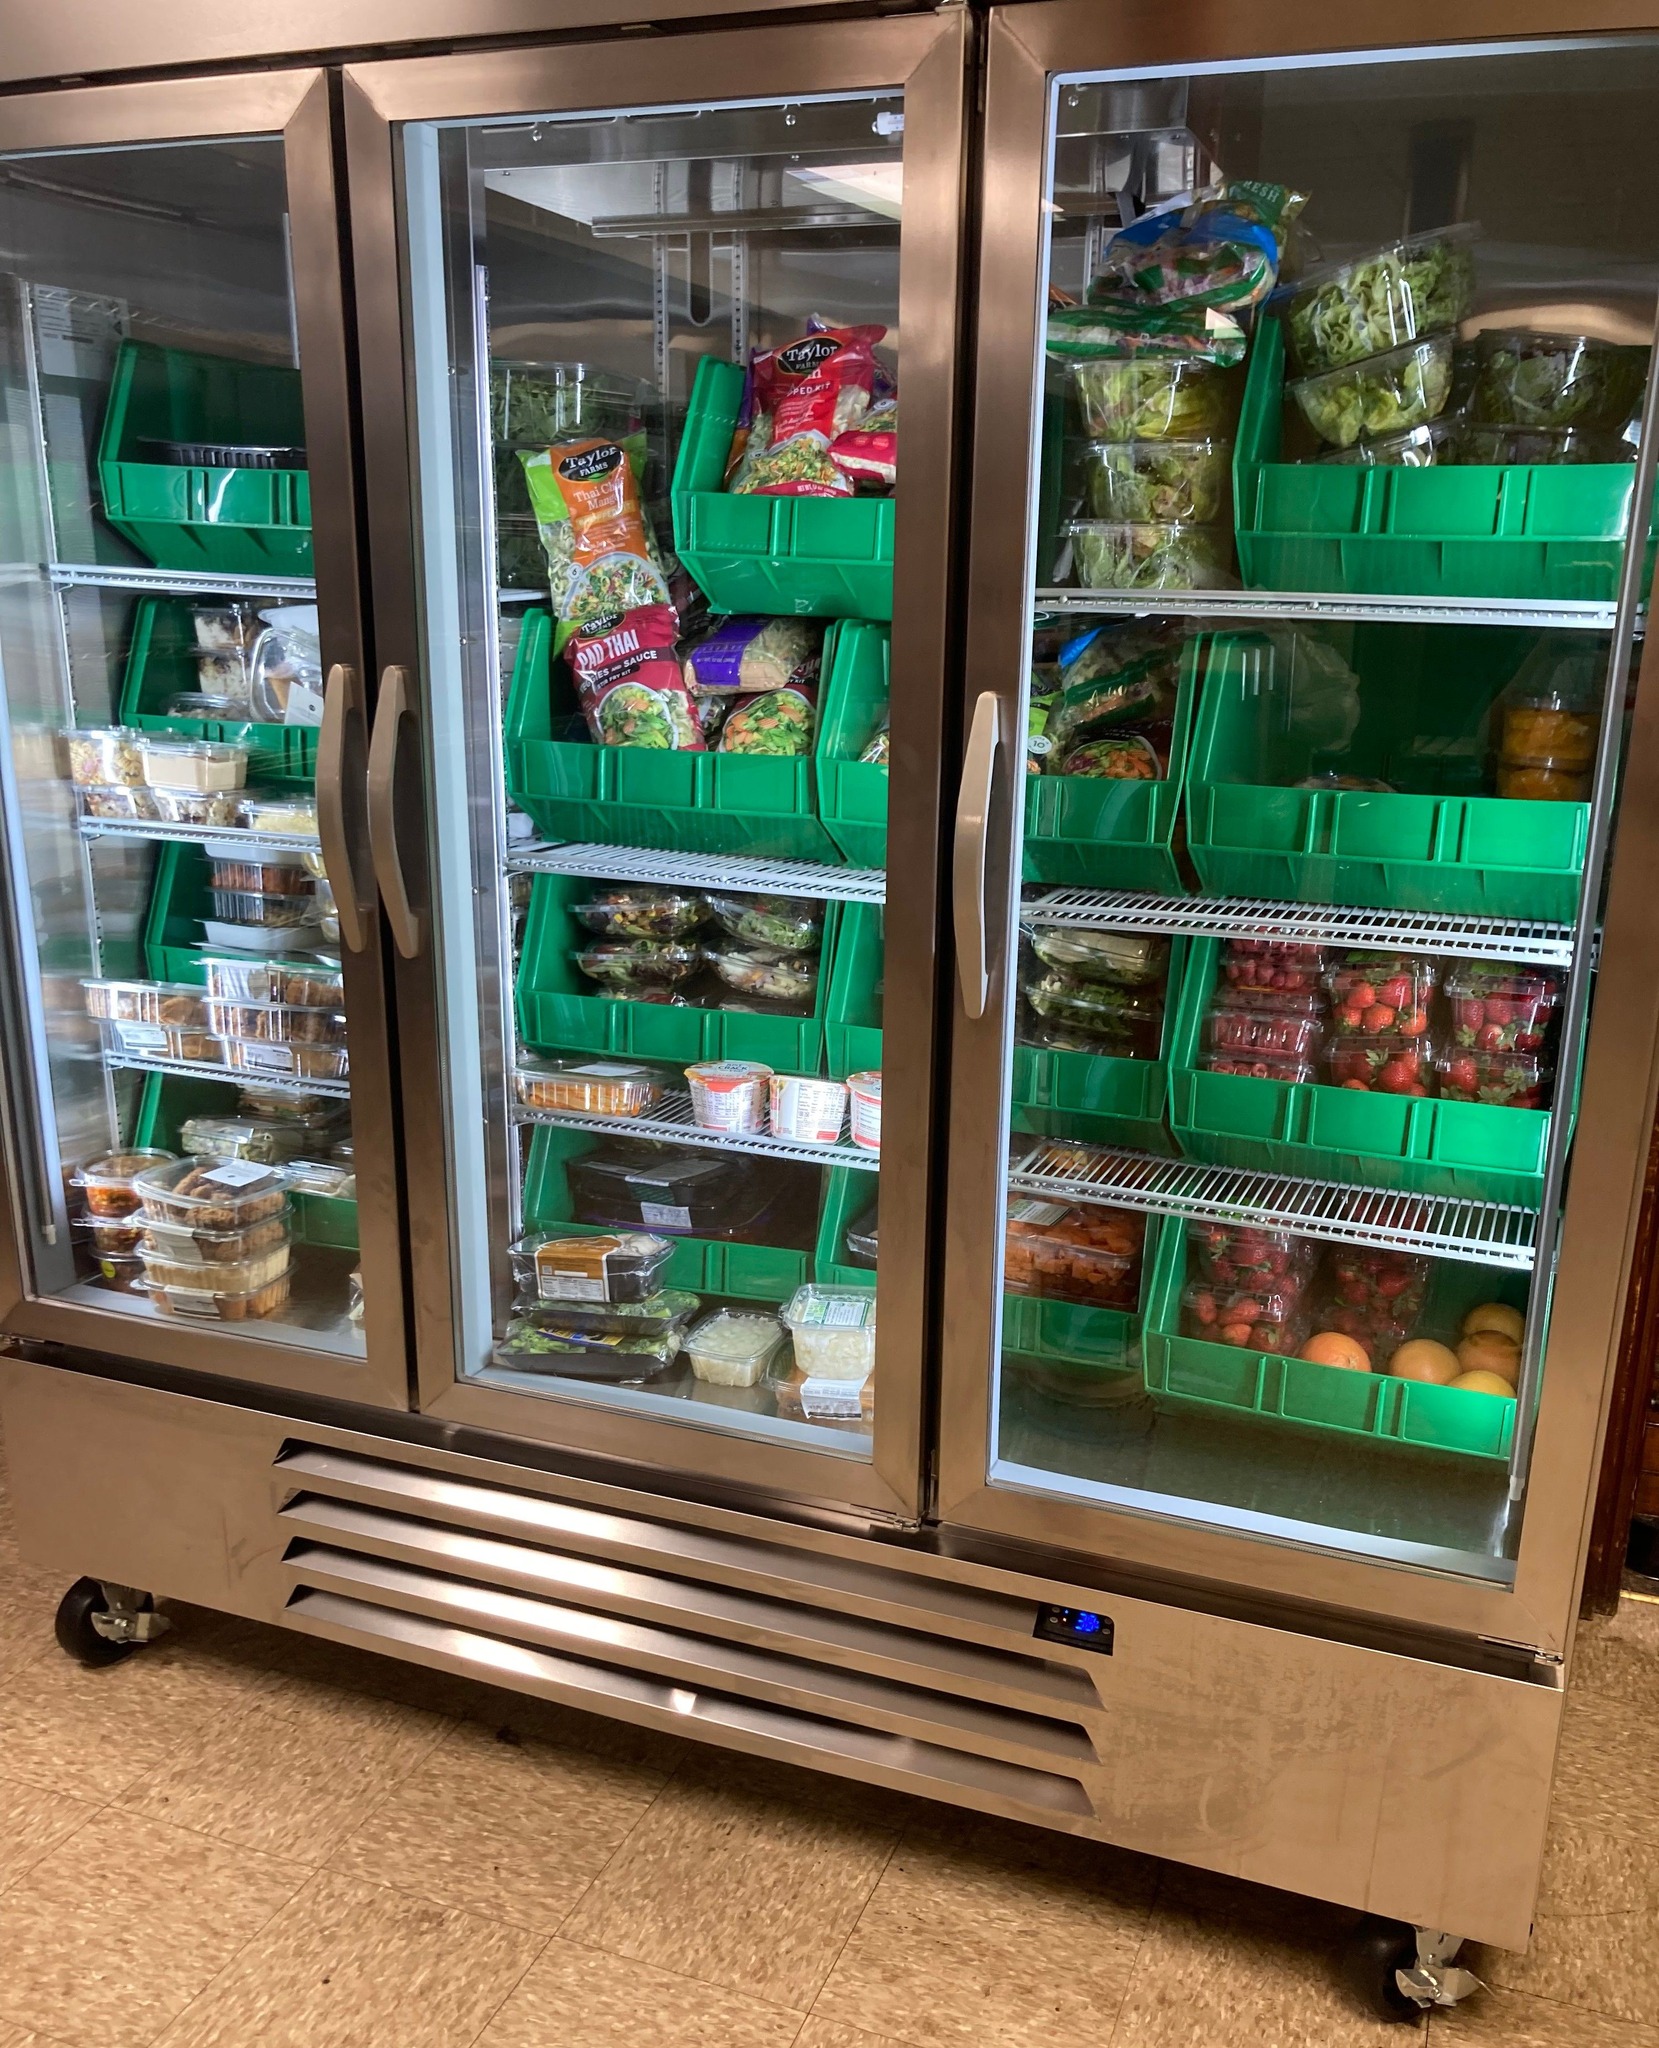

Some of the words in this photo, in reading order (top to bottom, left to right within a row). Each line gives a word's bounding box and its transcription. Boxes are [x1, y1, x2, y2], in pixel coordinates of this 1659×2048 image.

[786, 343, 838, 362] Taylor
[795, 361, 820, 370] FARM
[565, 446, 618, 469] Taylor
[579, 461, 609, 477] FARMS
[573, 486, 601, 503] Thai
[587, 494, 618, 511] Mang
[581, 612, 618, 634] Taylor
[576, 643, 606, 671] PAD
[603, 628, 640, 659] THAI
[623, 650, 658, 668] SAUCE
[609, 673, 621, 682] FRY
[621, 668, 632, 677] KIT
[1033, 740, 1045, 749] 10
